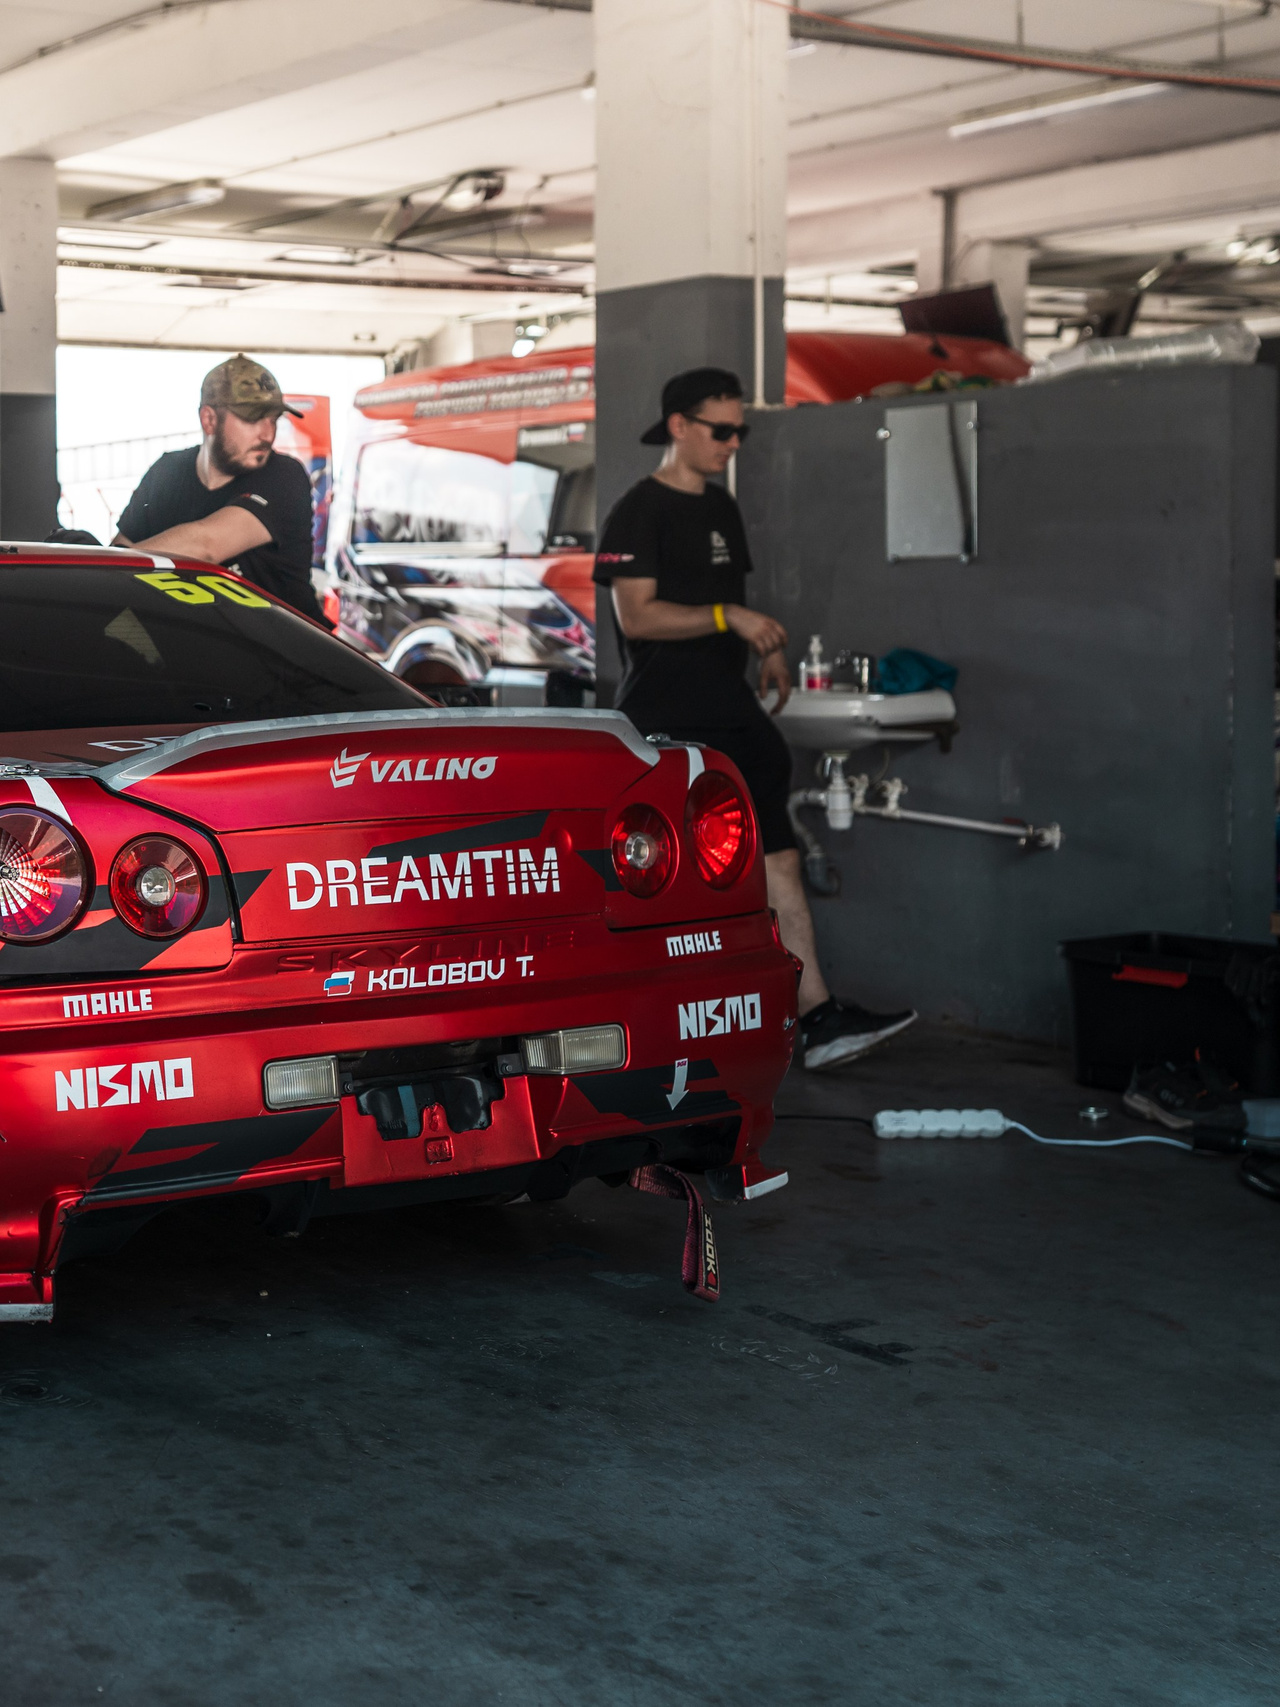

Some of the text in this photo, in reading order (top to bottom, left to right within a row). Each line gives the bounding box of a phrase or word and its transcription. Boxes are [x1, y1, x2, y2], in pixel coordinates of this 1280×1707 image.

[134, 573, 272, 608] 50
[370, 755, 499, 784] VALINO
[287, 846, 561, 912] DREAMTIM
[666, 930, 723, 957] MAHLE
[367, 955, 535, 992] KOLOBOV T.
[62, 988, 153, 1018] MAHLE
[677, 992, 762, 1041] NISMO
[54, 1057, 195, 1112] NISMO
